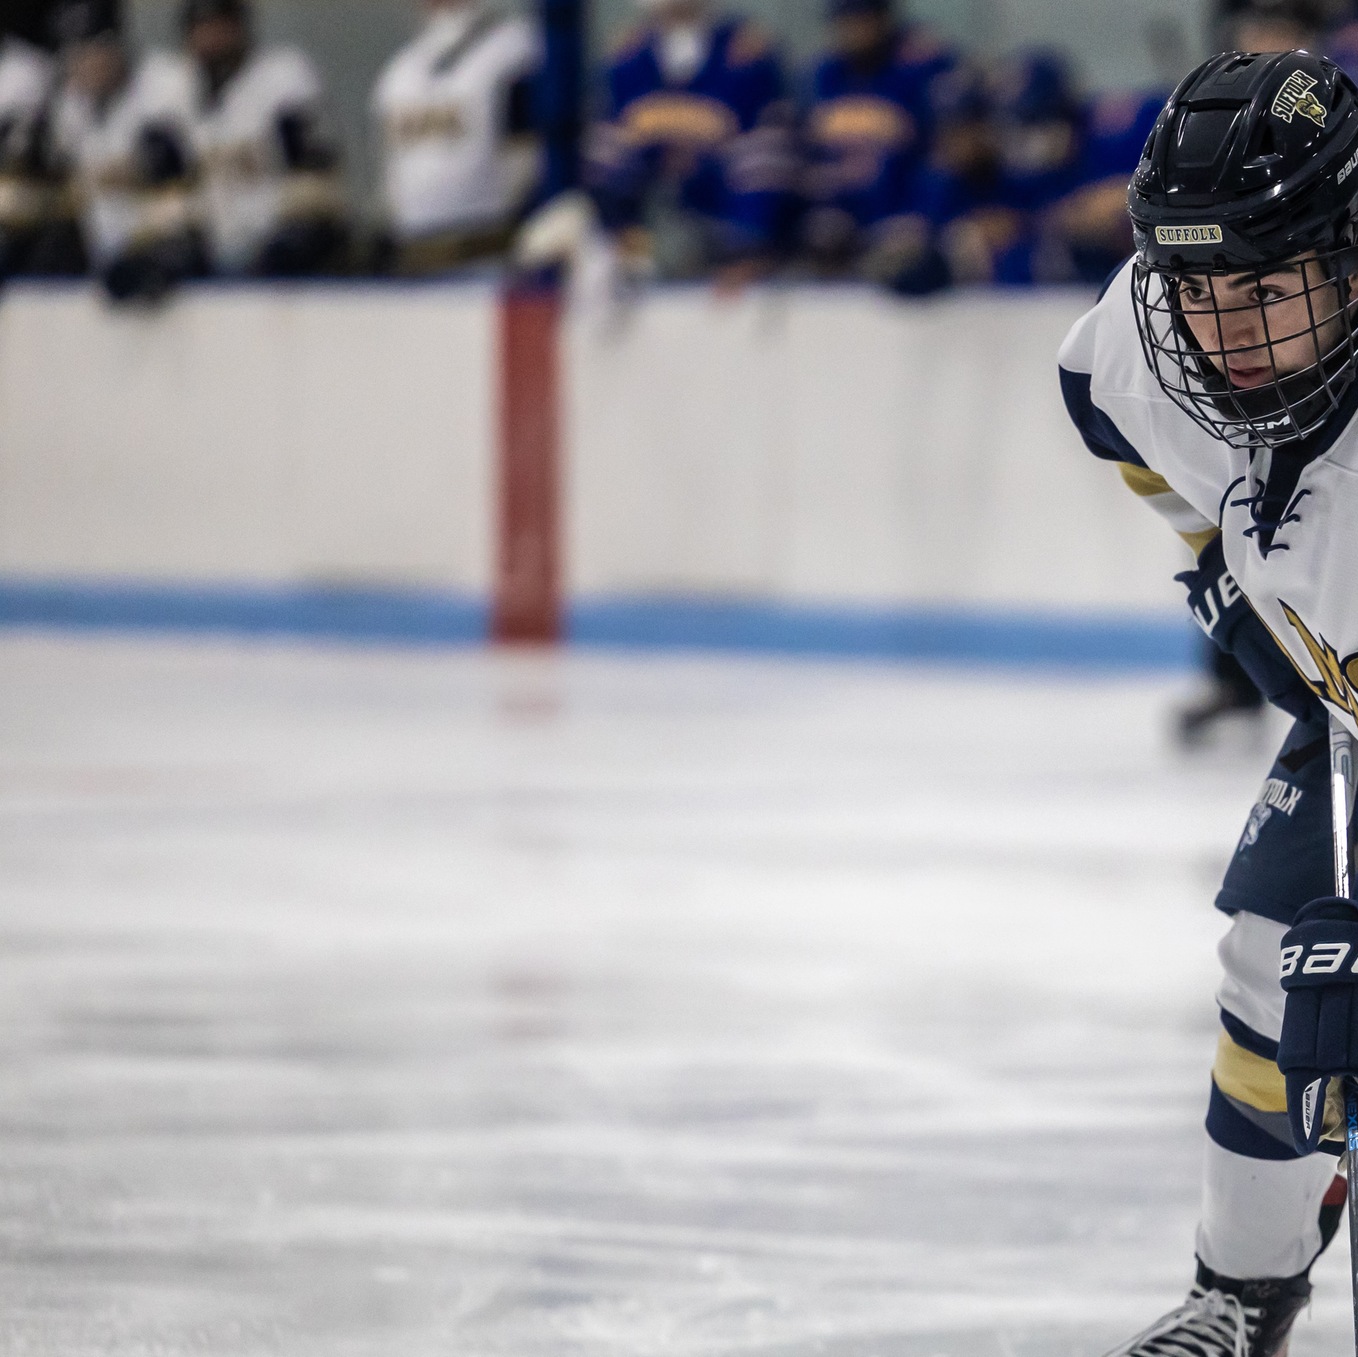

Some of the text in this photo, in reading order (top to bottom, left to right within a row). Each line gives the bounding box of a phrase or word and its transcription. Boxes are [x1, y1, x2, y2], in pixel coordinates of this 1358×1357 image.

[1271, 70, 1318, 123] SUFFOLK
[1158, 226, 1219, 242] SUFFOLK
[1304, 1092, 1312, 1130] BAUER
